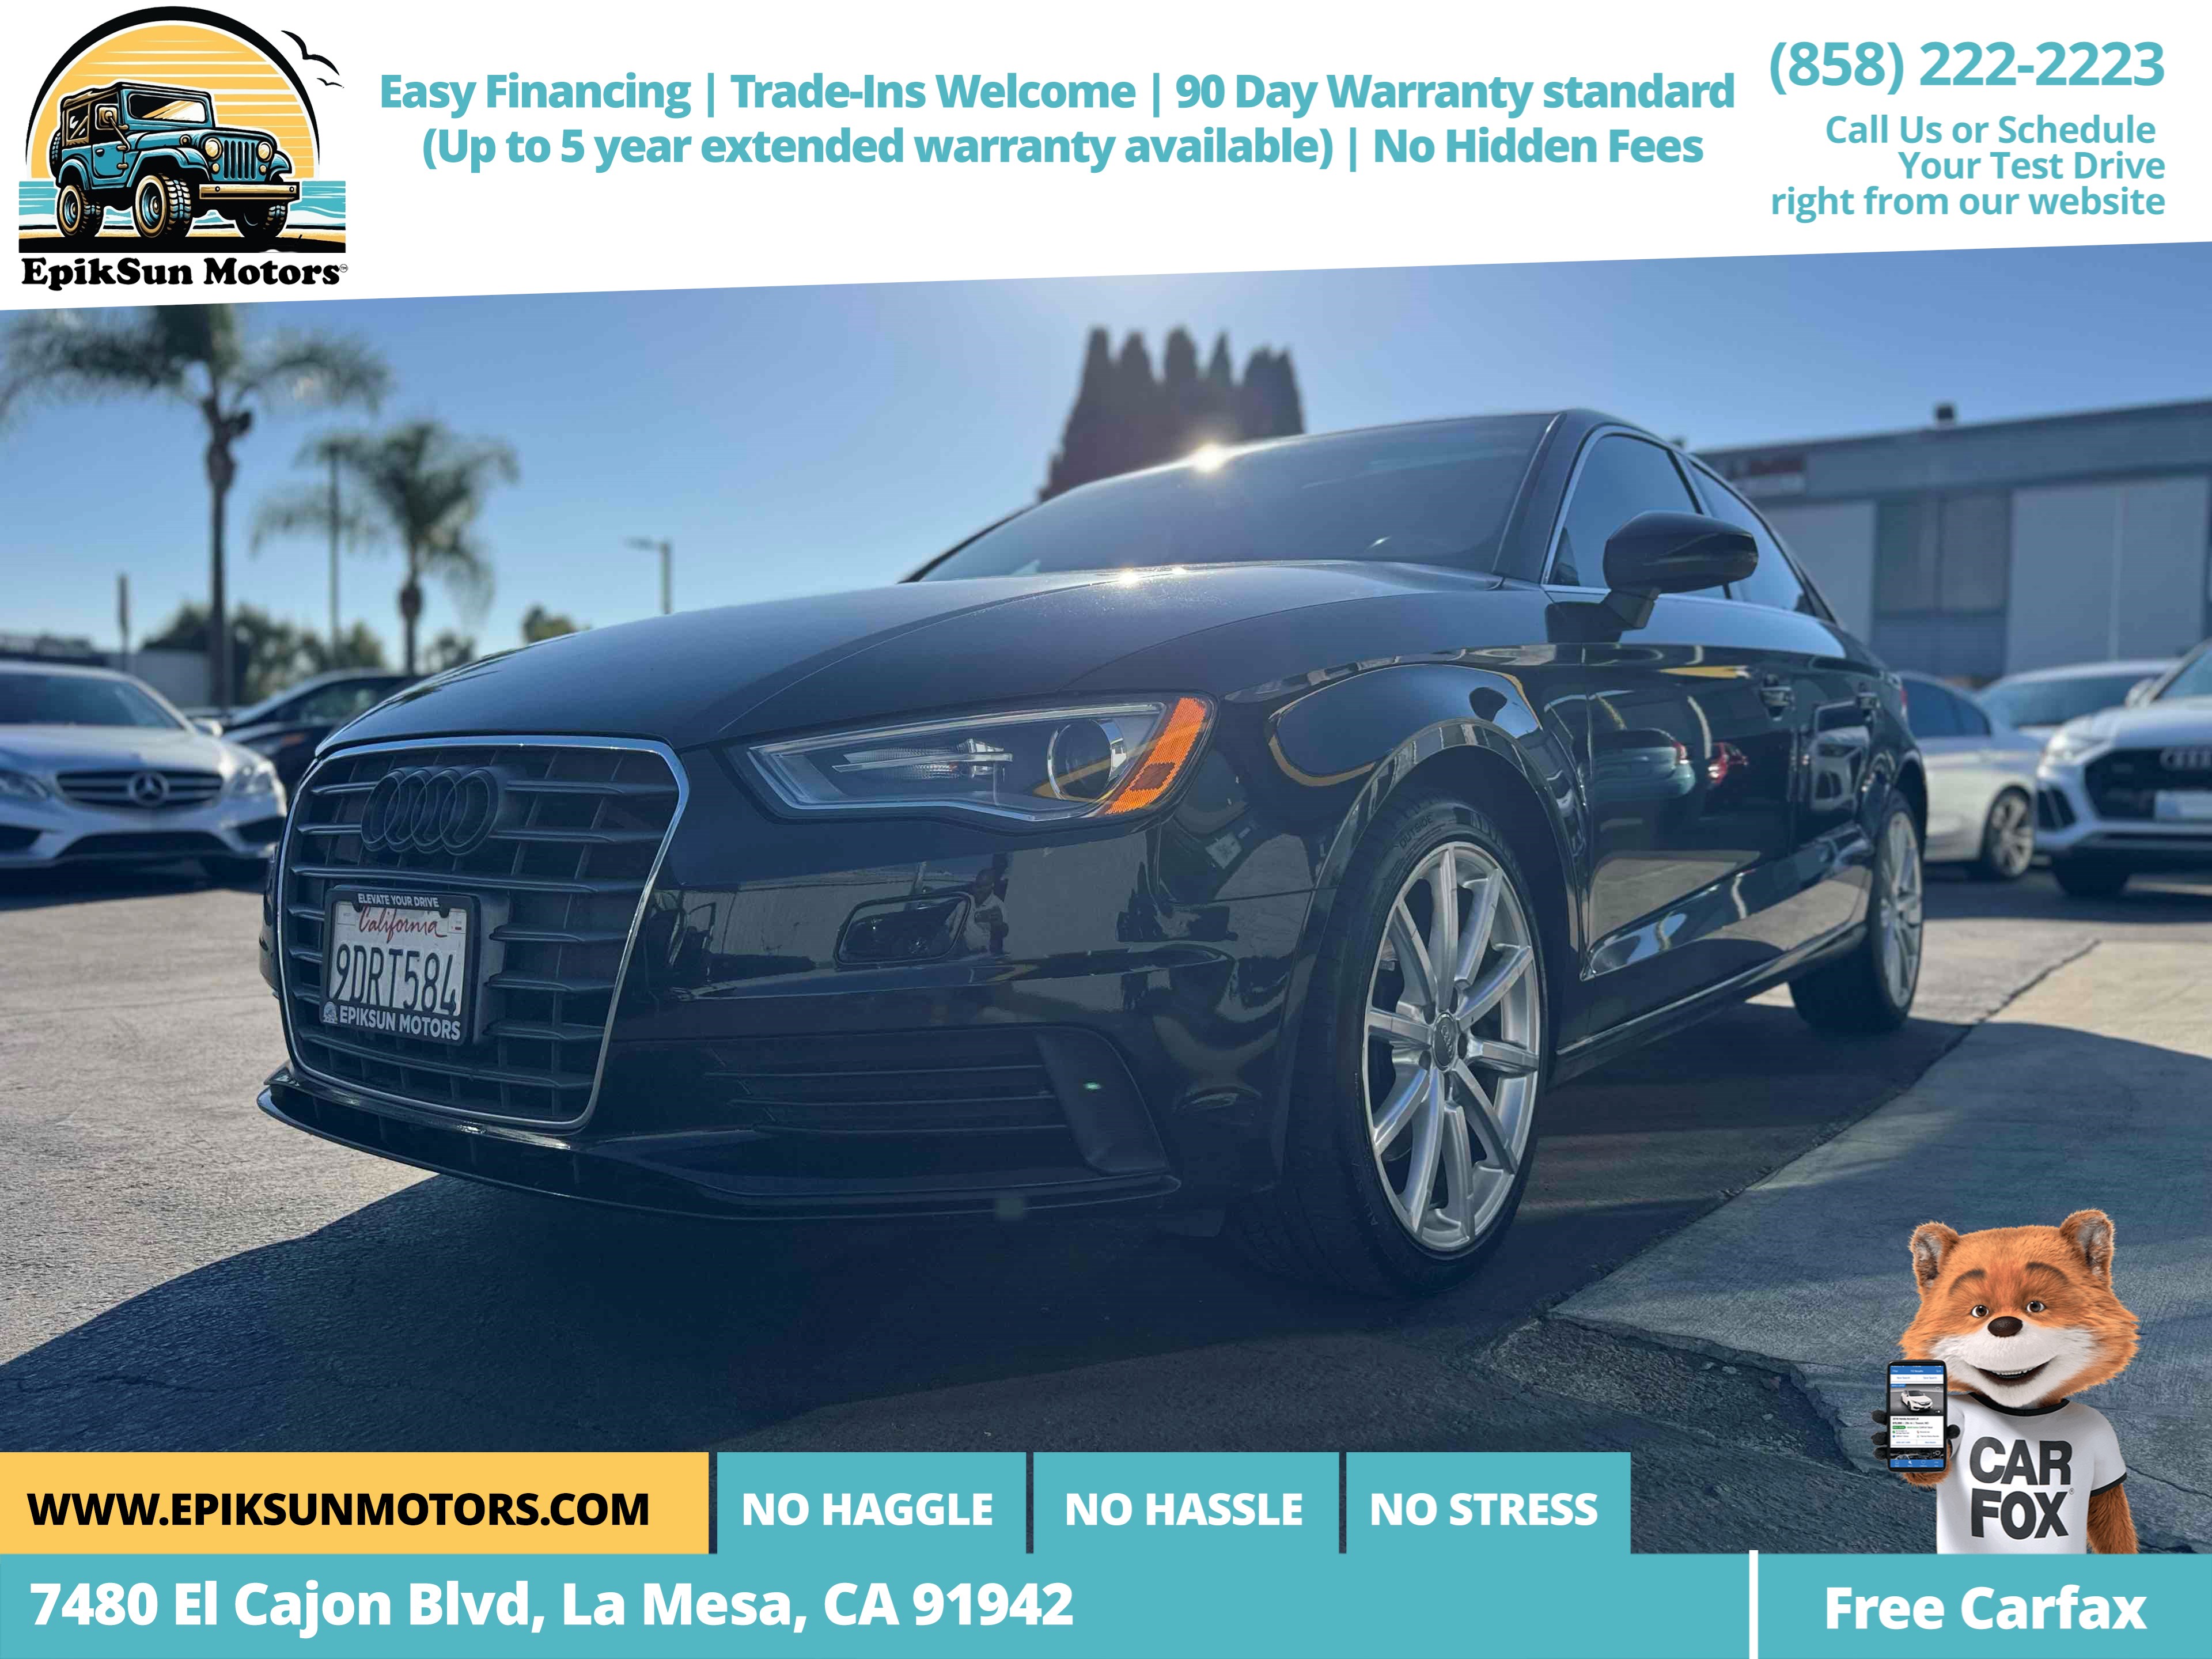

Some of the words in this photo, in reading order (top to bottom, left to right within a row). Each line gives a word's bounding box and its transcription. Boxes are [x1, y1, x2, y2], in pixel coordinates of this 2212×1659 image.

[1399, 815, 1433, 849] OUTSIDE
[358, 894, 390, 904] ELEVATE
[391, 895, 412, 906] YOUR
[414, 897, 440, 907] DRIVE
[359, 904, 448, 944] California
[333, 943, 457, 1014] 9DRT584
[339, 1005, 396, 1031] EPIKSUN
[399, 1013, 461, 1040] MOTORS
